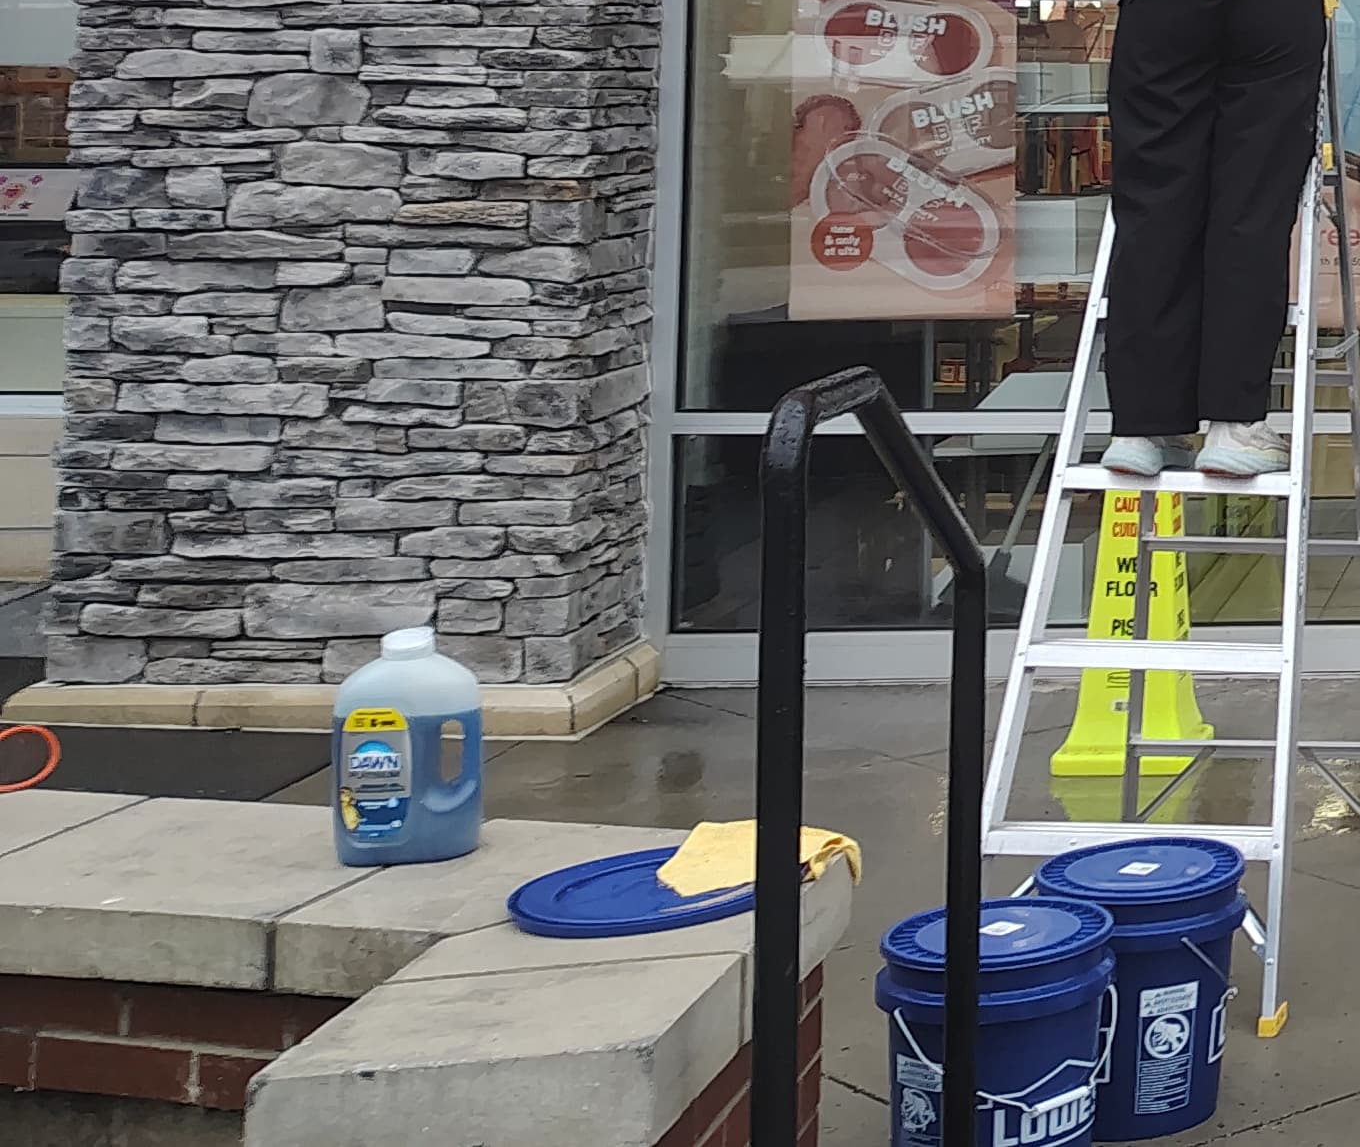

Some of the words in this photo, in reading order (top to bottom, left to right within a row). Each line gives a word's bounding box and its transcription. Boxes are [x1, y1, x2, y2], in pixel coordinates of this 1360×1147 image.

[864, 7, 947, 36] BLUSH
[911, 90, 995, 129] BLUSH
[1105, 580, 1159, 598] FLOR
[1111, 619, 1135, 637] PIS
[350, 755, 399, 770] DAWN
[992, 1084, 1096, 1147] LOWE
